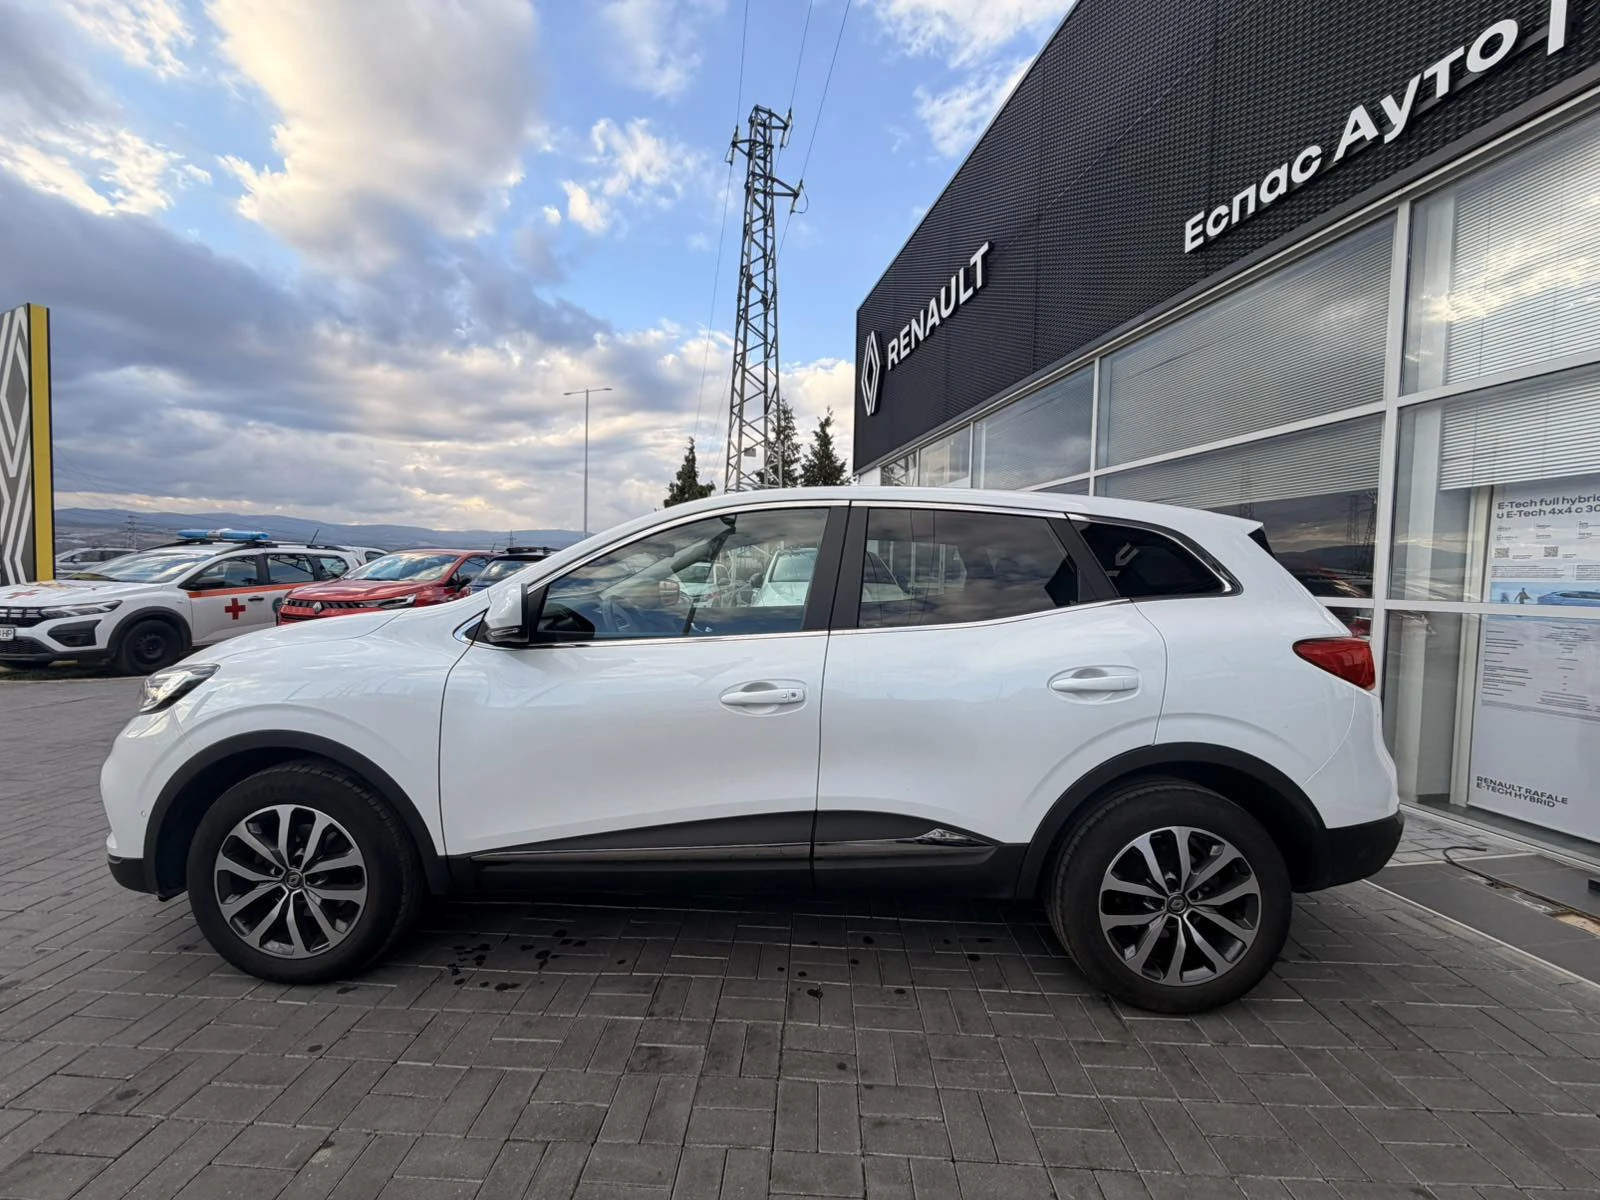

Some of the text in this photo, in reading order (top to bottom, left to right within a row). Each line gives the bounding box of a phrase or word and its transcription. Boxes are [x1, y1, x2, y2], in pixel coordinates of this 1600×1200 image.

[1185, 145, 1322, 254] Еспас
[1333, 19, 1519, 163] Ауто
[888, 241, 990, 371] RENAULT
[1497, 499, 1537, 510] E-Tech
[1540, 496, 1560, 506] full
[1506, 508, 1547, 519] E-Tech
[1548, 505, 1573, 516] 4x4
[1476, 775, 1569, 805] RENAULT RAFALE
[1476, 781, 1556, 808] E-TECH HYBRID
